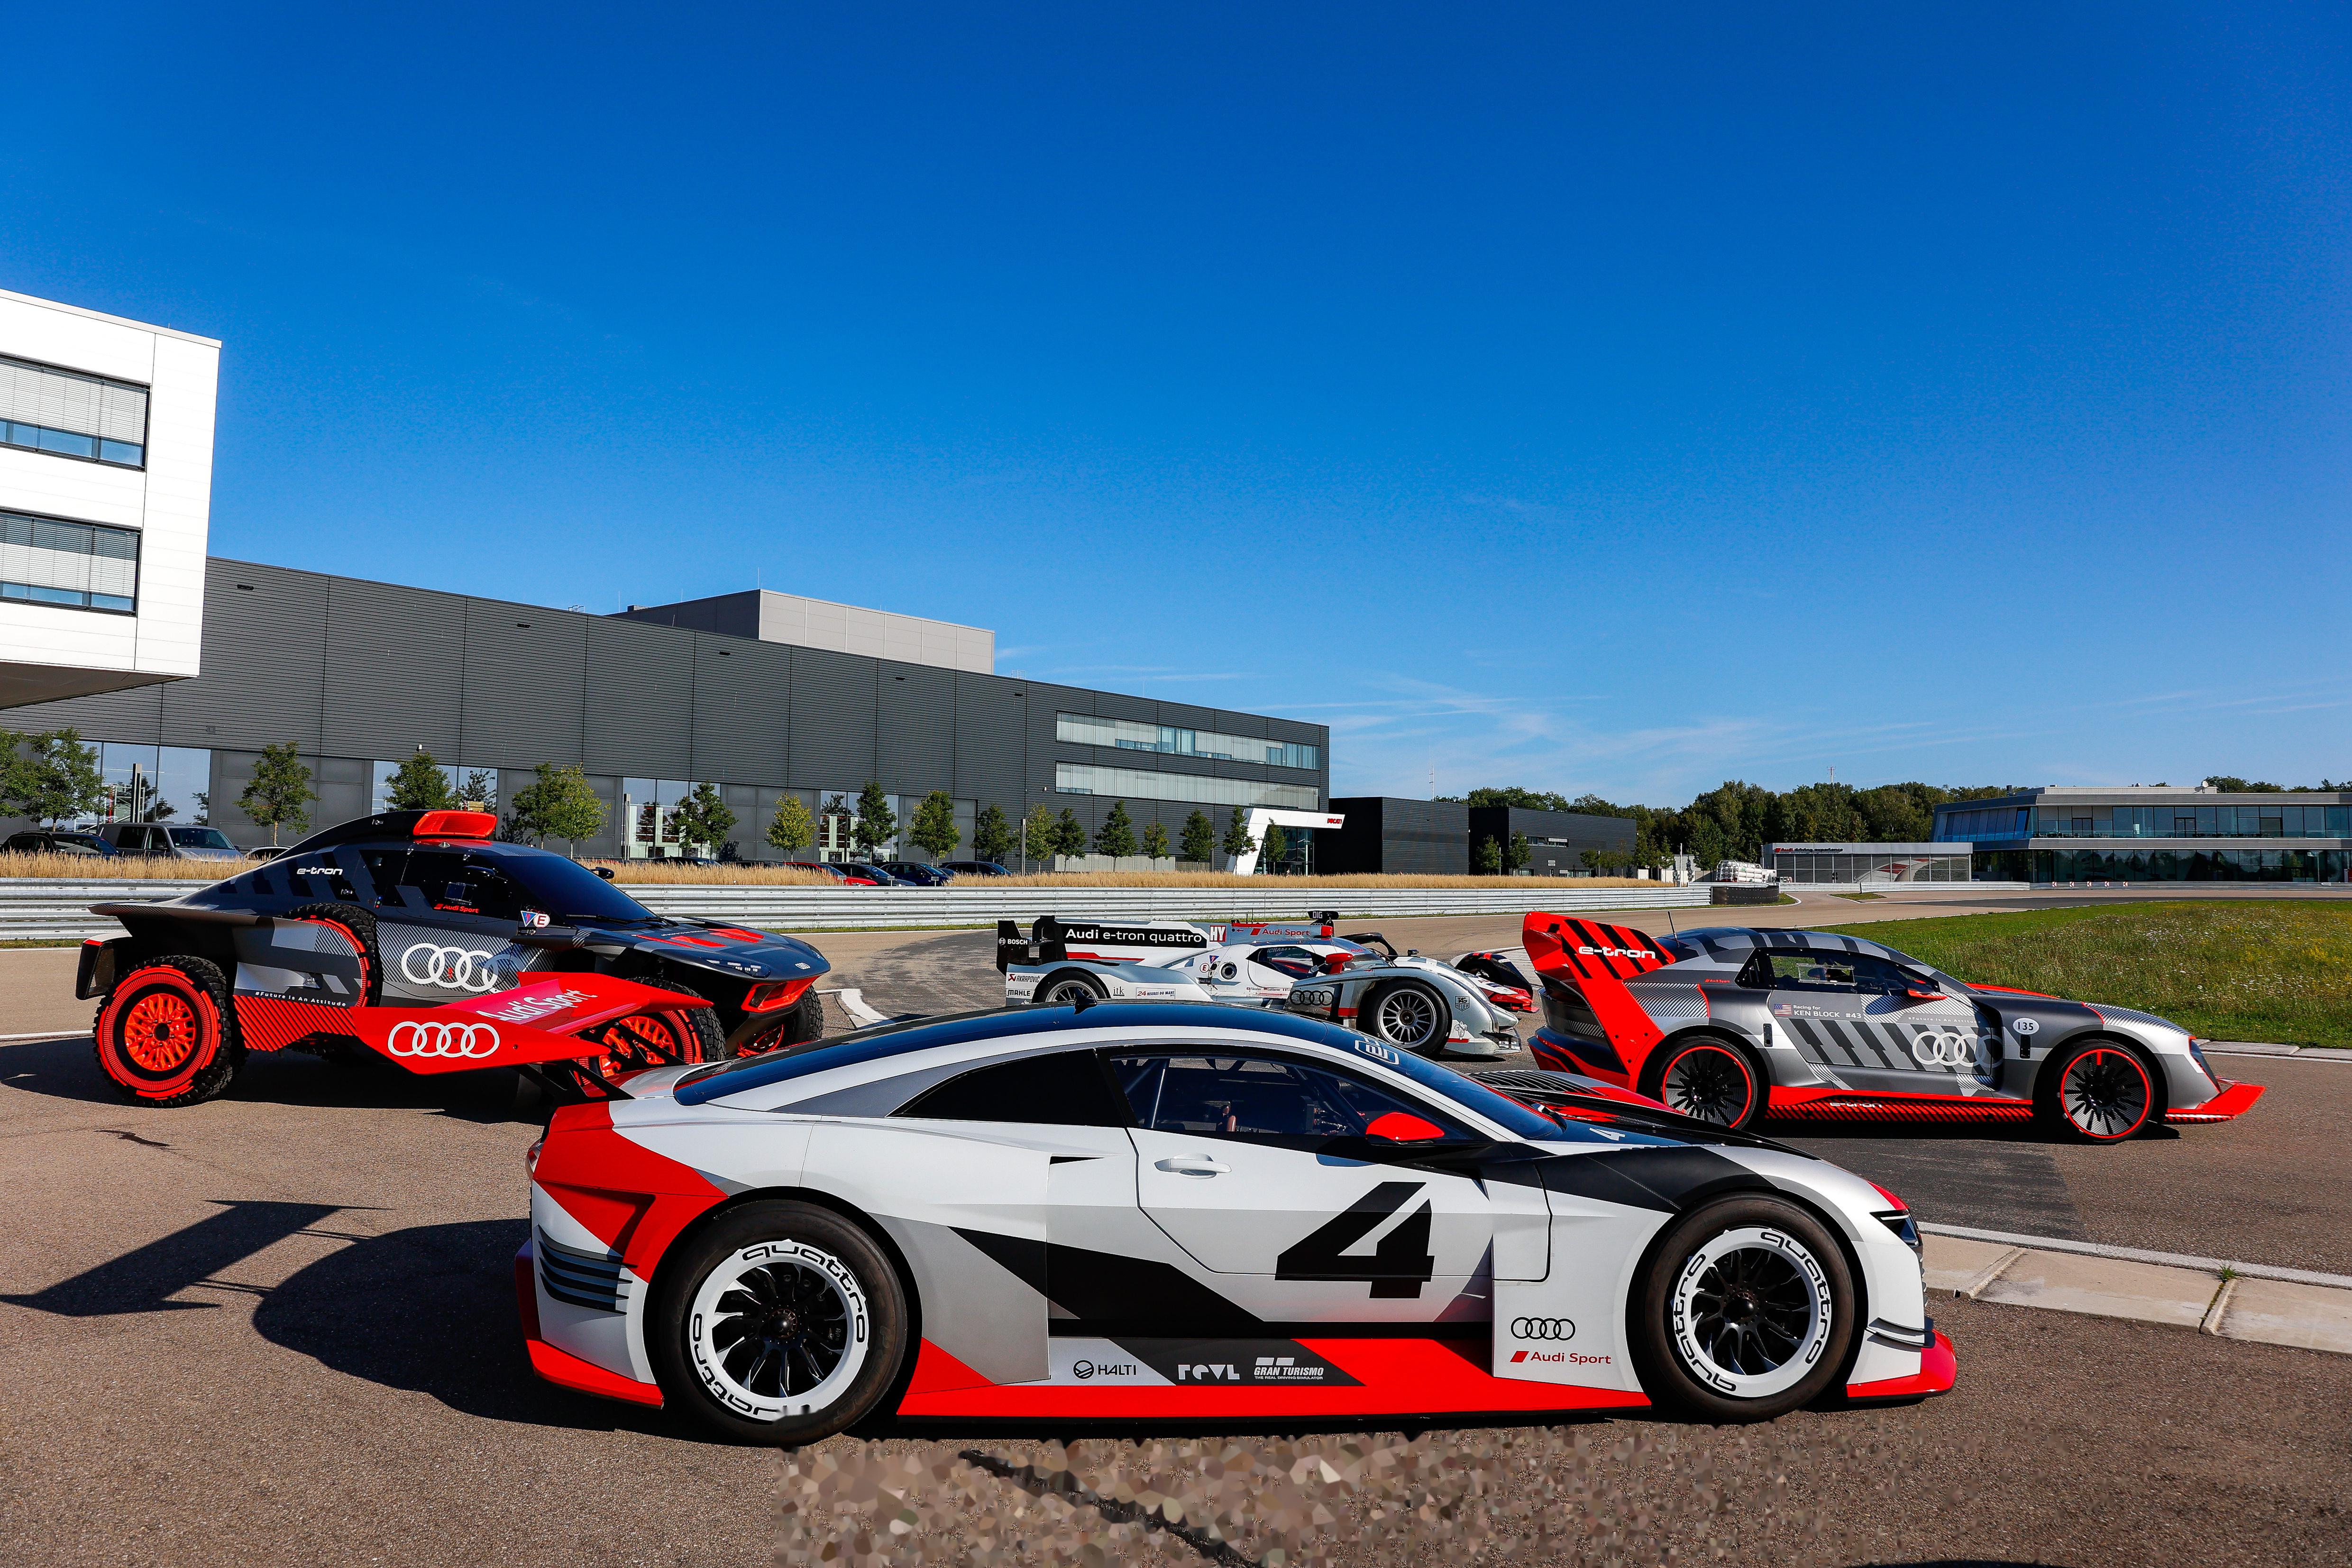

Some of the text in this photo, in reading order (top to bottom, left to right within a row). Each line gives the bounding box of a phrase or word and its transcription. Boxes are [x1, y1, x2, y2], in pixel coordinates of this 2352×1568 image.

[297, 867, 343, 875] e-tron
[537, 916, 546, 925] E
[1312, 911, 1323, 919] DIG
[1066, 929, 1202, 944] Audi e-tron quattro
[1210, 926, 1226, 941] HY
[1578, 946, 1656, 959] e-tron
[1113, 986, 1124, 994] itk
[311, 998, 346, 1007] Attitude
[476, 989, 598, 1021] Audi Sport
[2017, 1021, 2034, 1031] 135
[1274, 1181, 1435, 1299] 4
[742, 1244, 866, 1343] quattro
[1760, 1231, 1832, 1364] quattro
[1674, 1253, 1736, 1392] quattro
[692, 1312, 811, 1416] uattro
[1530, 1351, 1611, 1365] Audi Sport
[1098, 1364, 1136, 1375] HALTI
[1254, 1367, 1324, 1376] GRAN TURISMO
